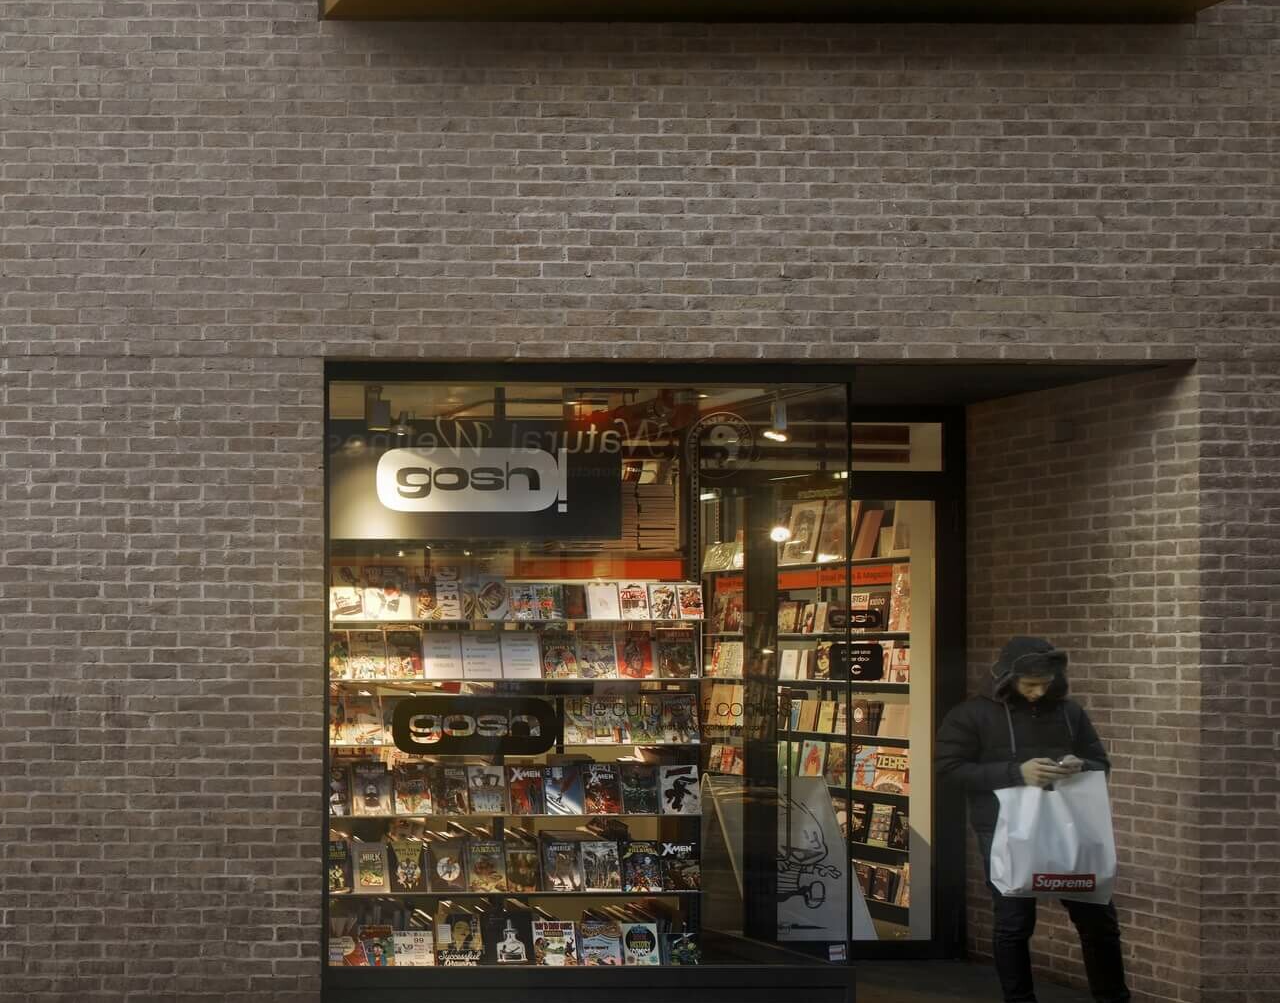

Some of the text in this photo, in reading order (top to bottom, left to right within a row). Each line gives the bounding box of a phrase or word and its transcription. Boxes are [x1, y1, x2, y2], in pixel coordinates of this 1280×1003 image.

[572, 701, 606, 717] the
[612, 701, 685, 717] culture
[1034, 875, 1094, 890] Supreme
